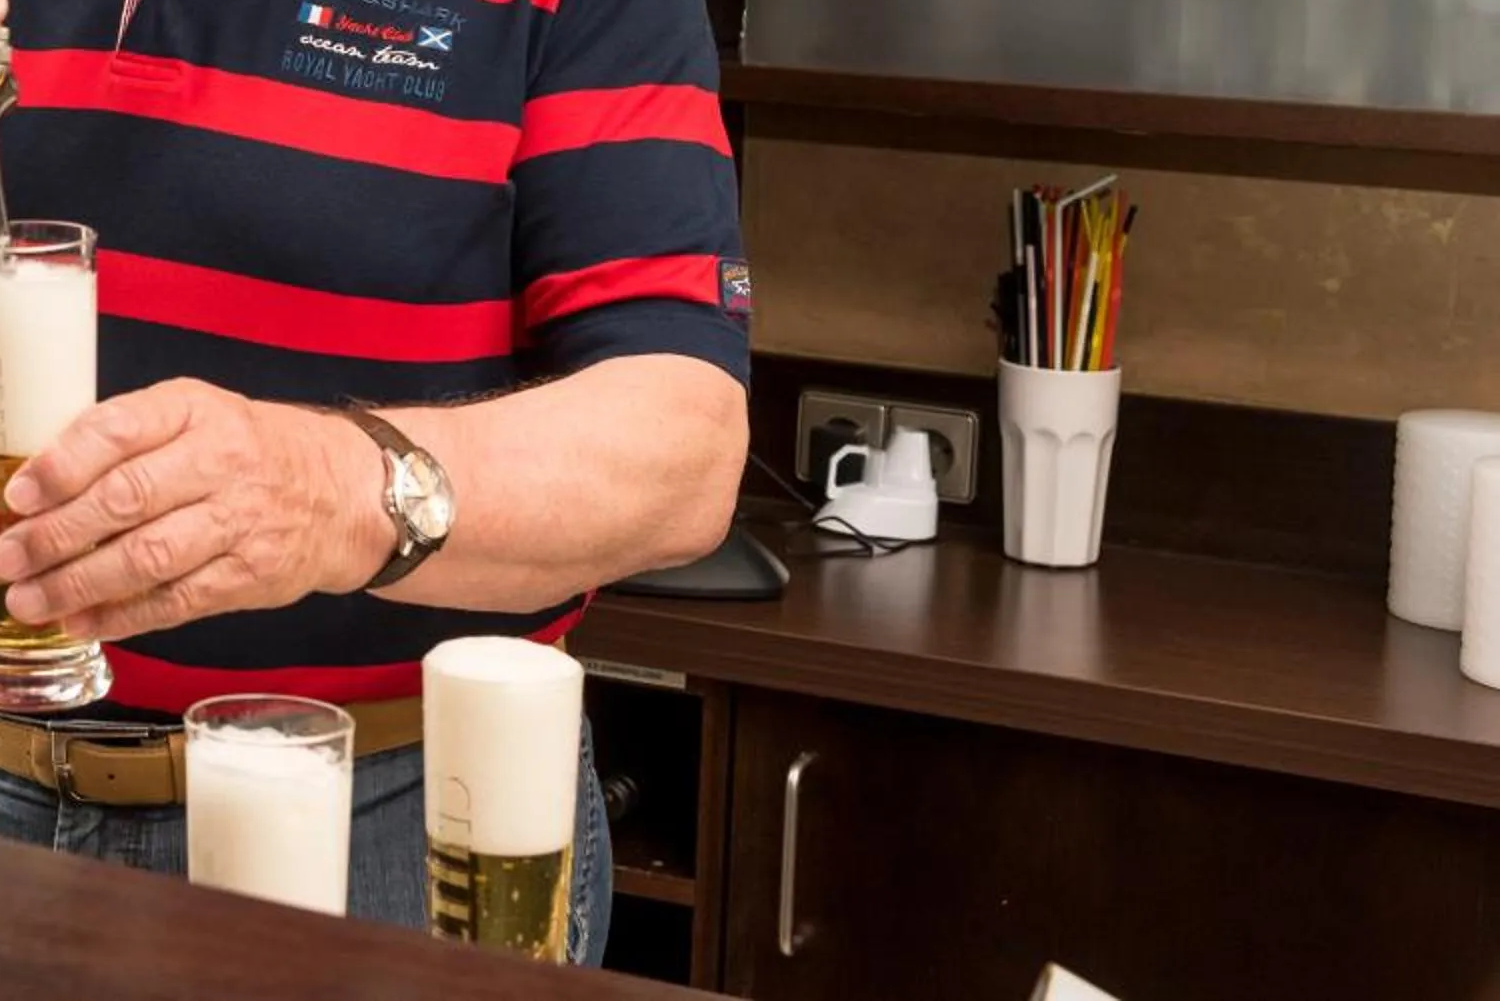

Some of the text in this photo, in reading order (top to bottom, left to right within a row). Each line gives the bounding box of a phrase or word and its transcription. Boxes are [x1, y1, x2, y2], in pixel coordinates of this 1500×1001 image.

[281, 50, 336, 81] ROYAL
[343, 64, 398, 91] YACHT
[299, 33, 441, 72] ocean team
